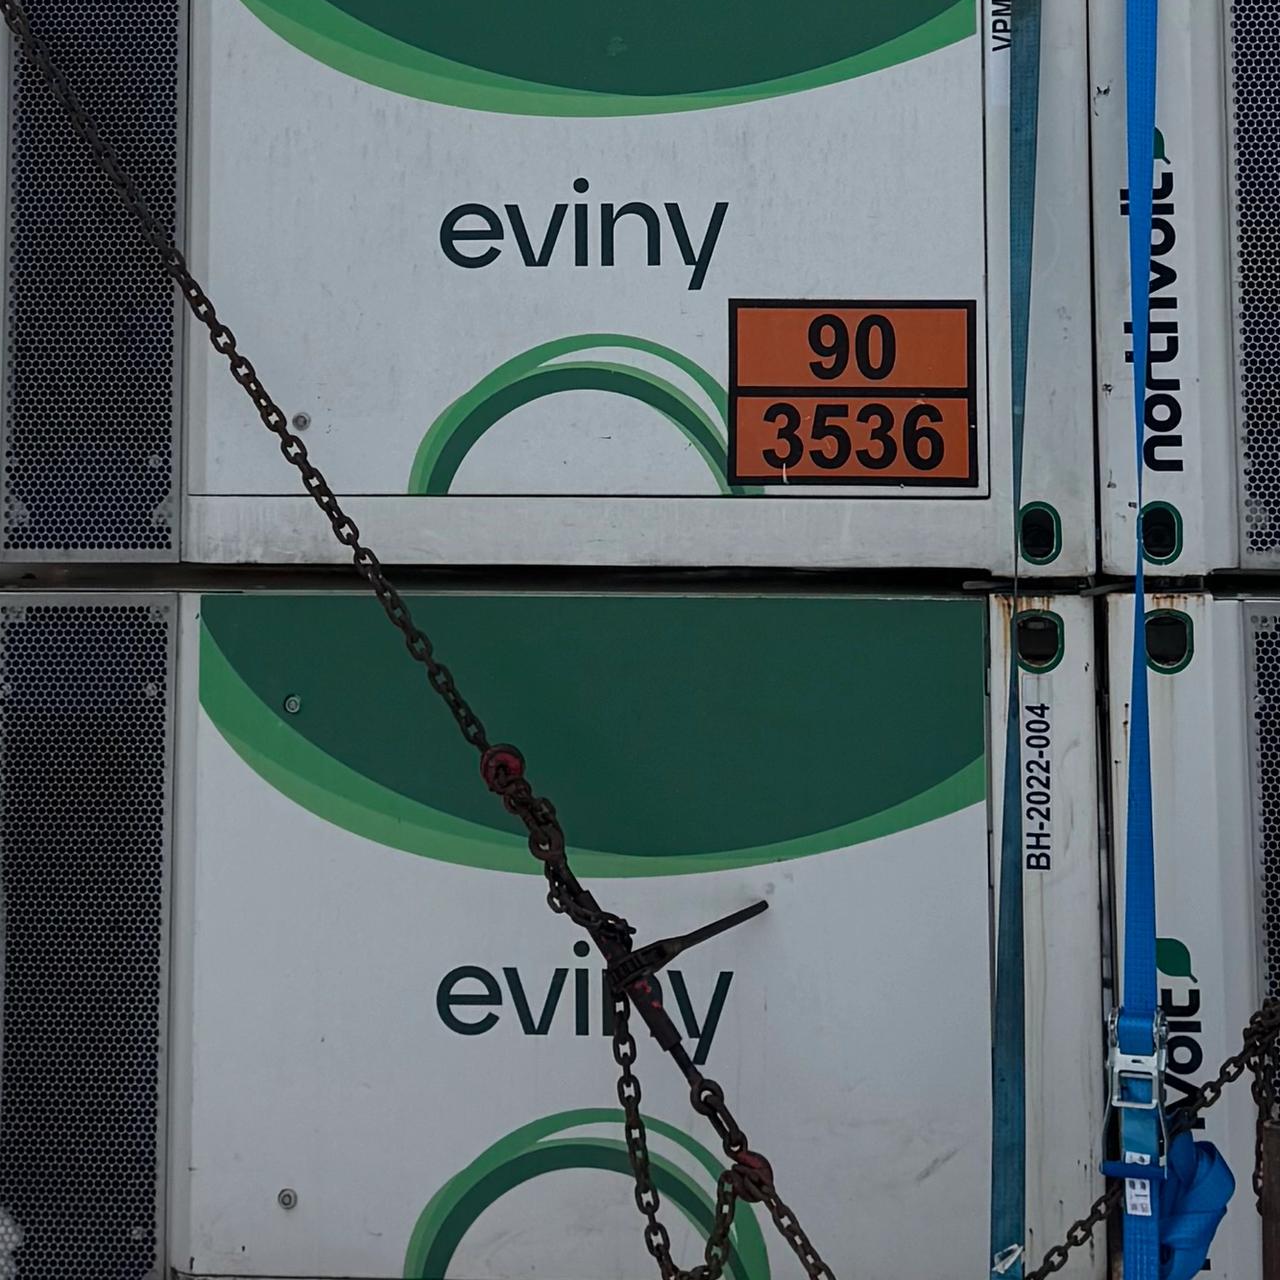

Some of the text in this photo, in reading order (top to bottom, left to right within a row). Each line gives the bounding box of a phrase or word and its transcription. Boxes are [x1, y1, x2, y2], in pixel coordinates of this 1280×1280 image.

[440, 178, 728, 290] eviny
[808, 314, 896, 380] 90
[763, 403, 944, 470] 3536
[1025, 703, 1051, 870] BH-2022-004
